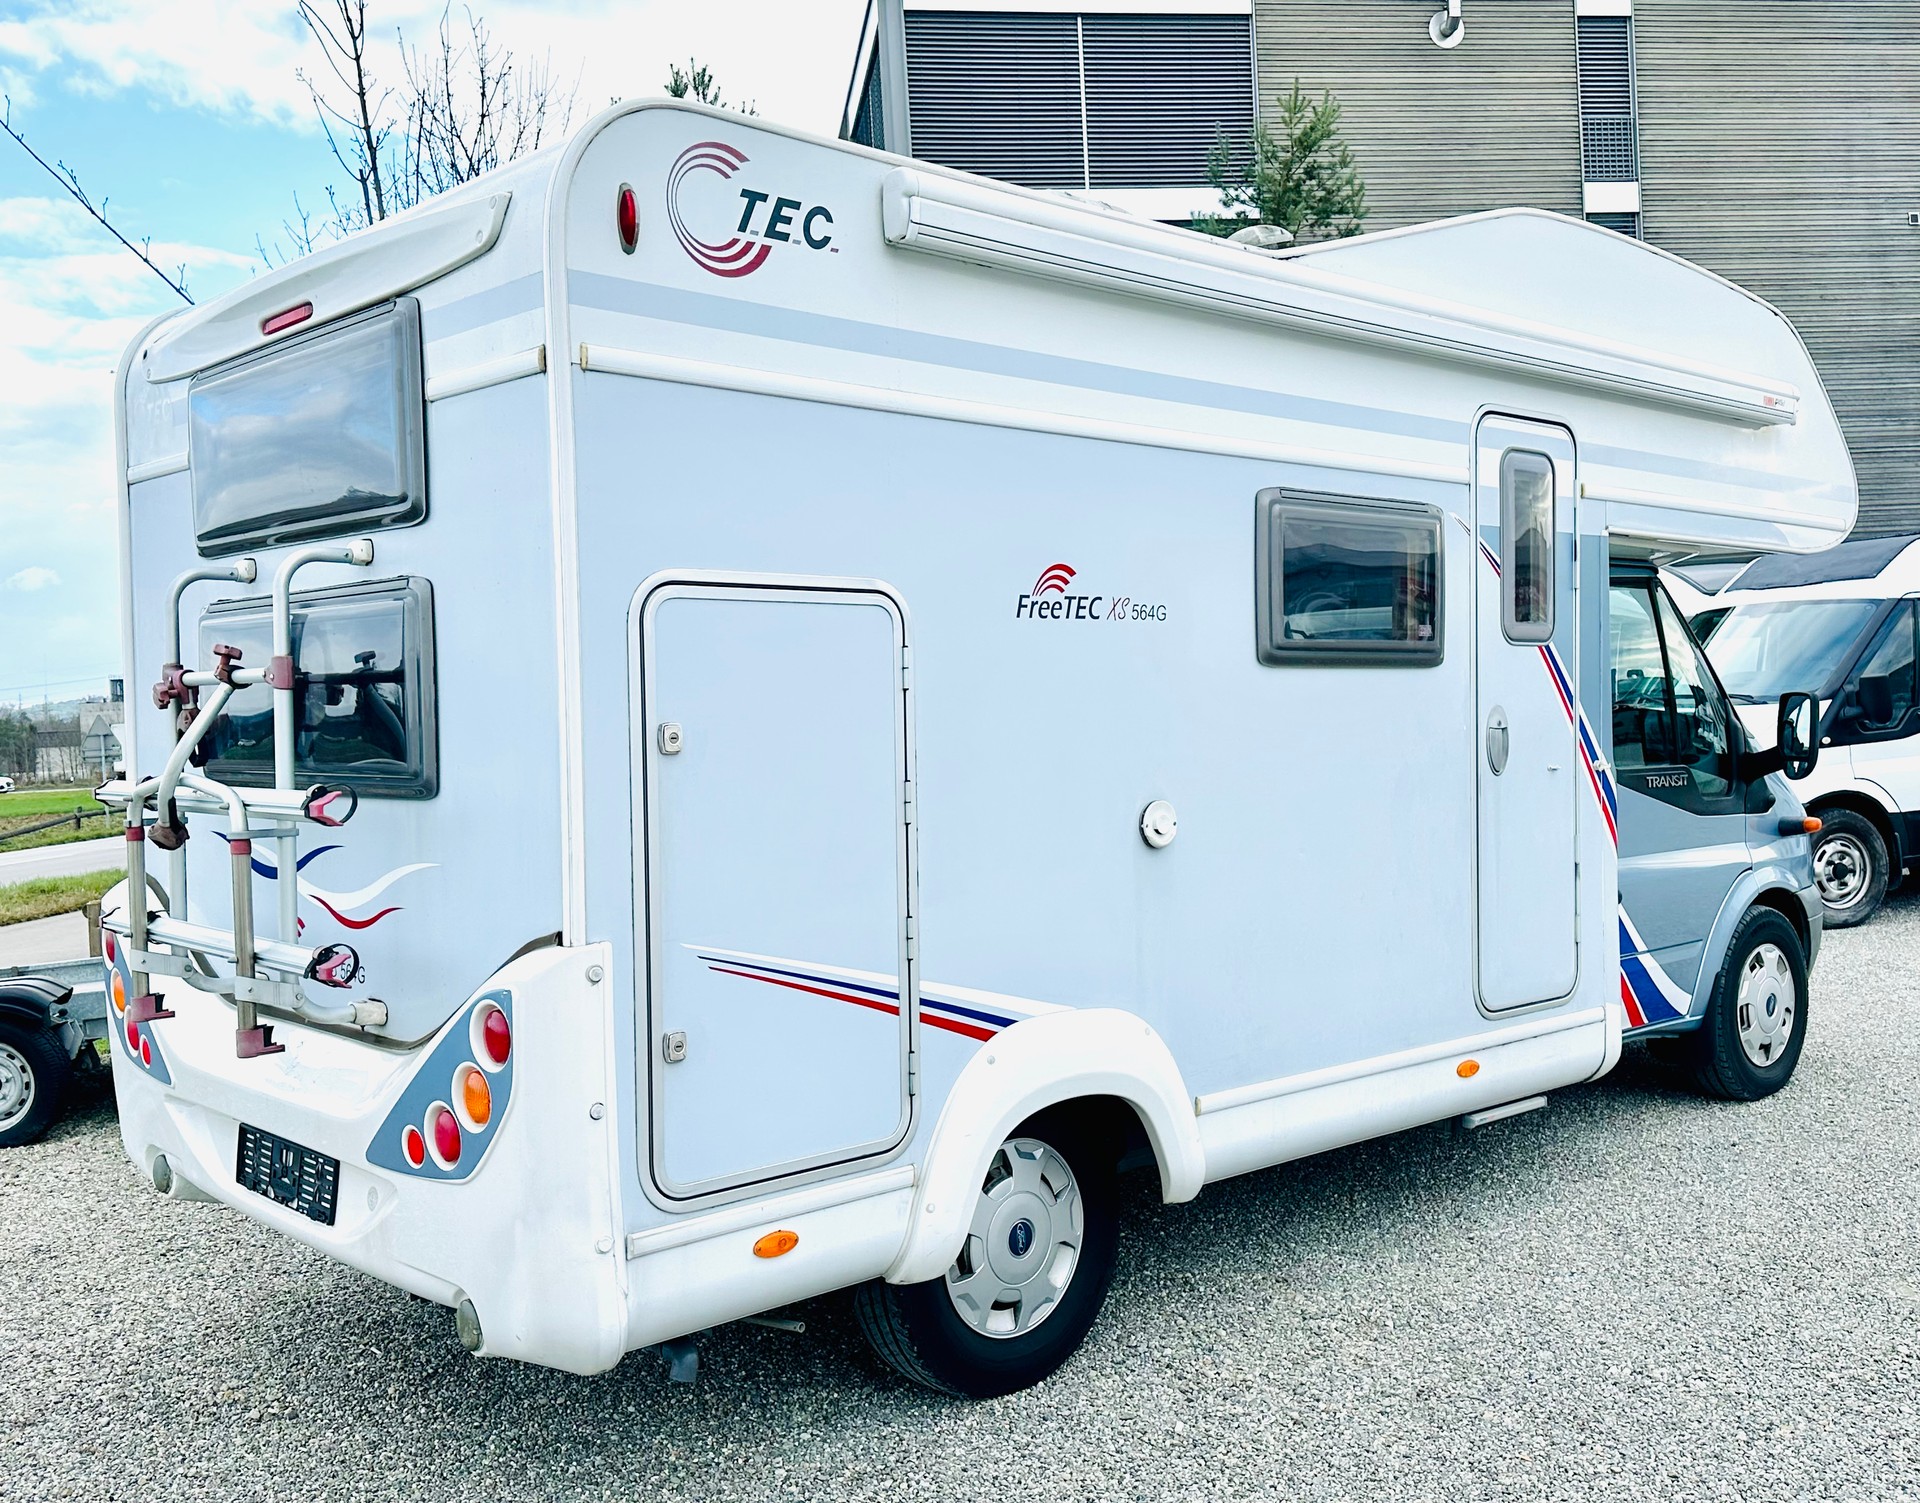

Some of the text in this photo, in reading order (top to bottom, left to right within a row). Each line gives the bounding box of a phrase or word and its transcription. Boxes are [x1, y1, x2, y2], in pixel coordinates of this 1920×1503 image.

[1016, 594, 1167, 622] FreeTEC XS 564G
[1646, 774, 1688, 788] TRANSIT
